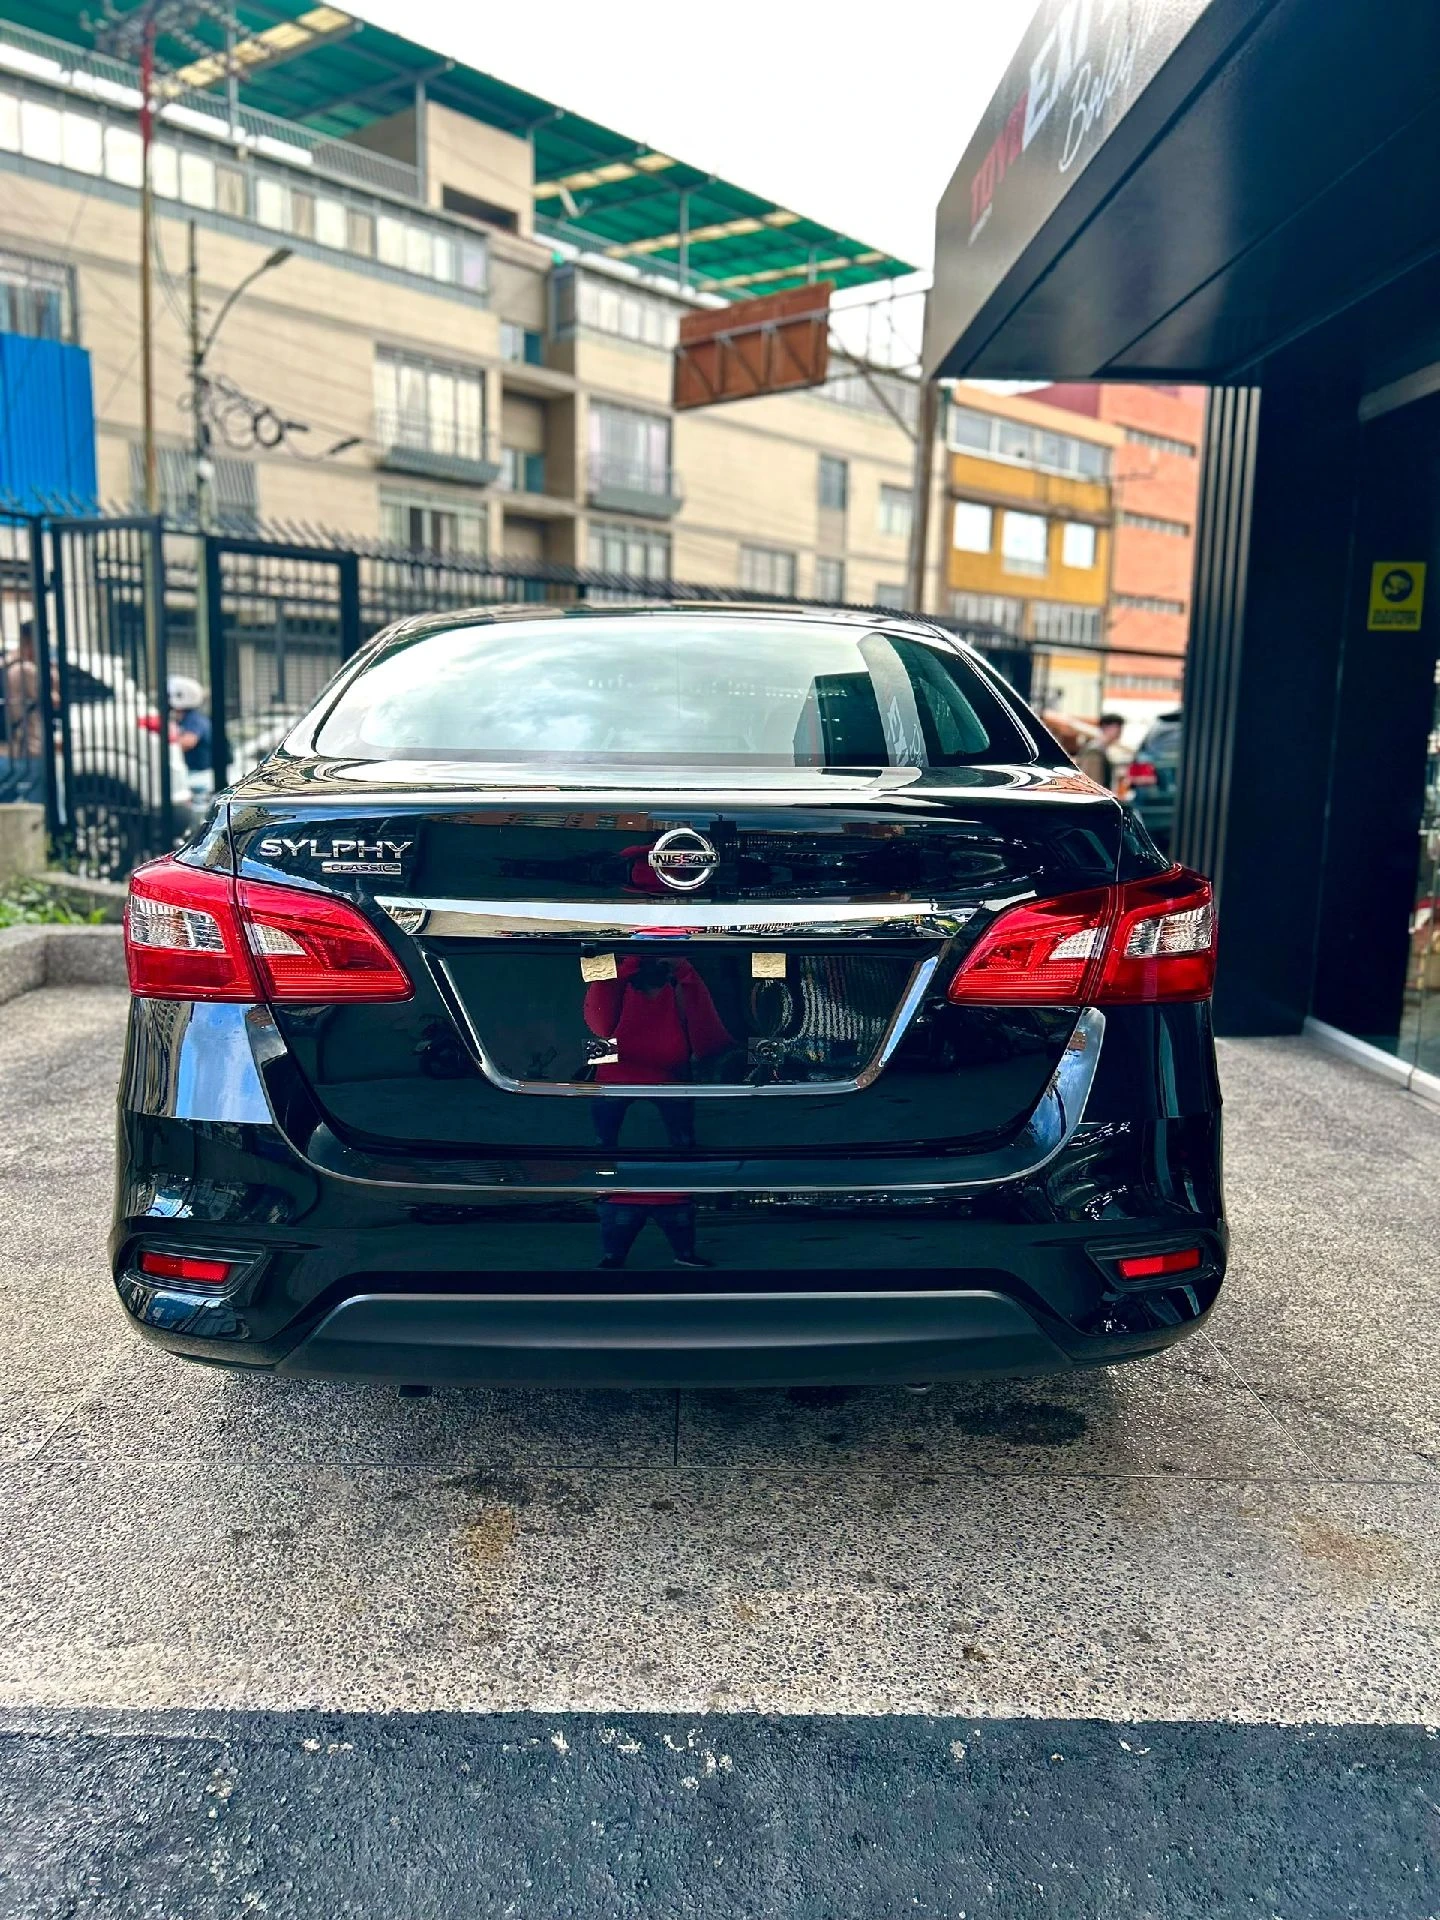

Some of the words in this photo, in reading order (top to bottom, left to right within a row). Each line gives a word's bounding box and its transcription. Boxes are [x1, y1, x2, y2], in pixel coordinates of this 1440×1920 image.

[259, 838, 413, 859] SYLPHY
[654, 853, 717, 865] NISSAN
[329, 862, 396, 874] CLASSIC
